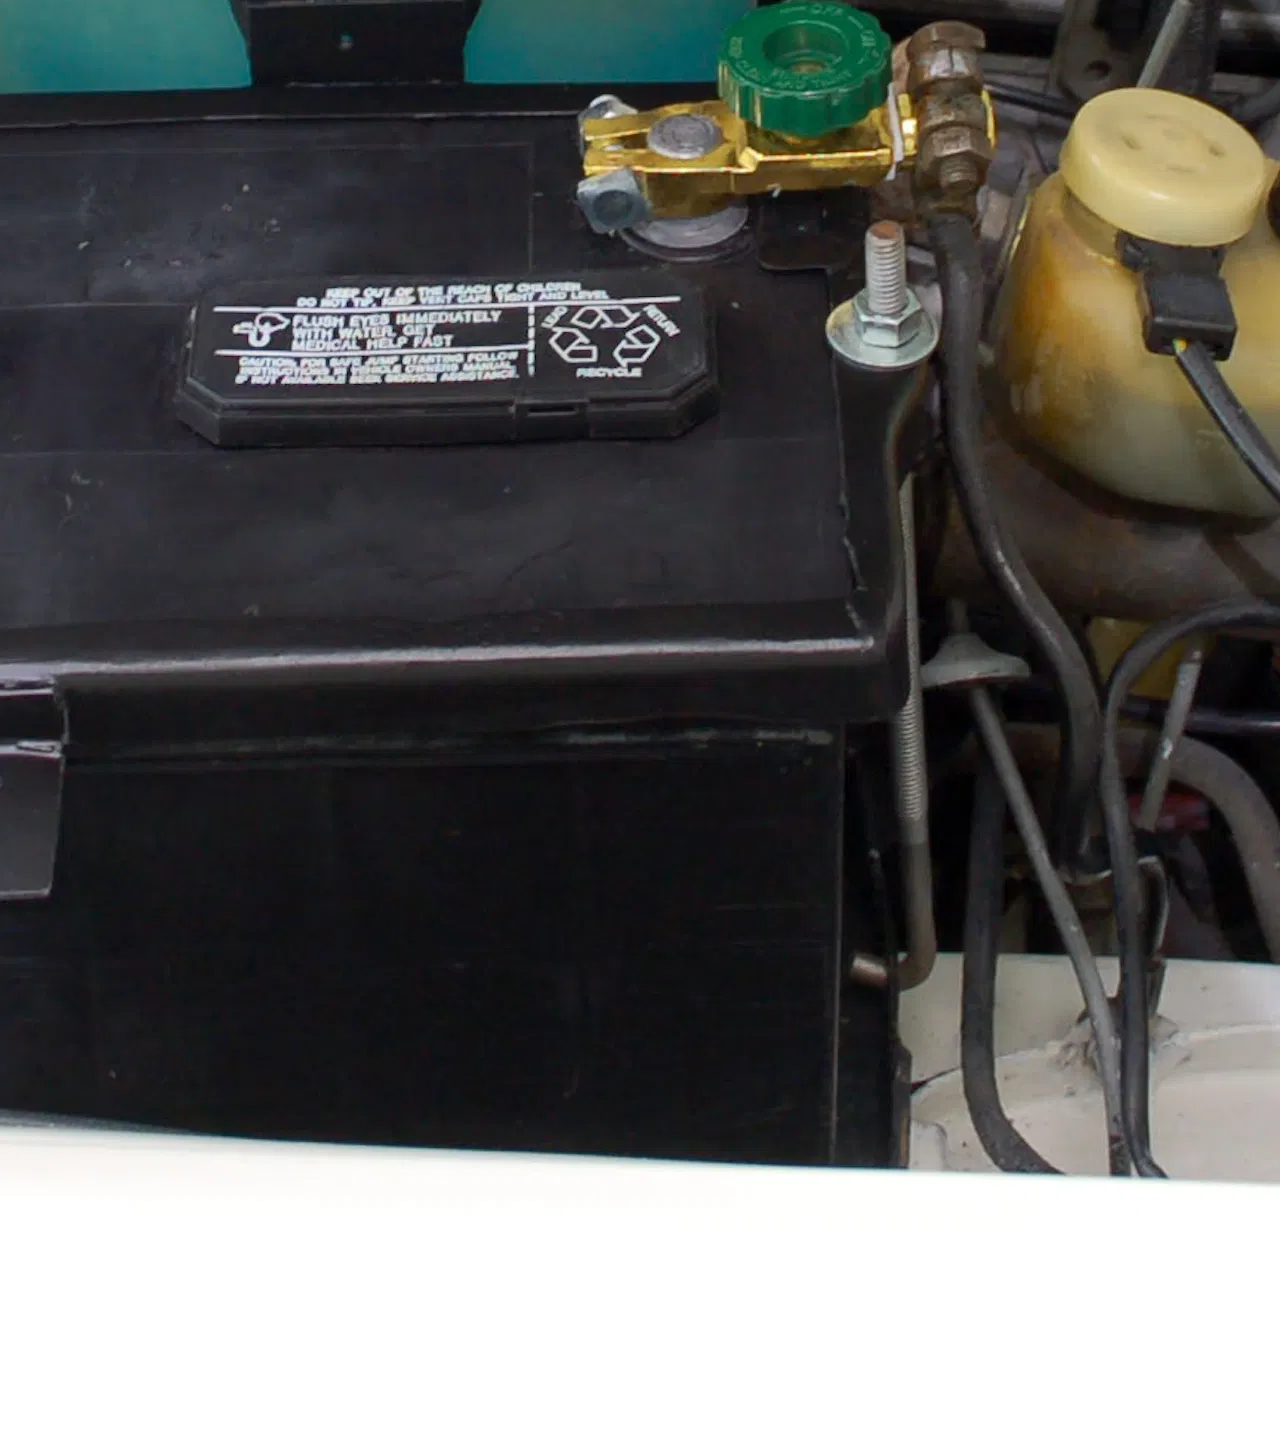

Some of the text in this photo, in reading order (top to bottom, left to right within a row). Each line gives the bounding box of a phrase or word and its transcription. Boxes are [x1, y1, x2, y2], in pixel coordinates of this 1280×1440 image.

[296, 296, 318, 308] DO
[320, 296, 348, 308] NOT
[381, 295, 417, 306] KEEP
[419, 294, 454, 305] VENT
[456, 292, 492, 303] CAPS
[497, 291, 535, 303] TIGHT
[538, 290, 568, 301] AND
[325, 281, 582, 299] KEEP OUT OF THE REACH OF CHILDREN
[292, 309, 502, 329] FLUSH EYES IMMEDIATELY
[540, 305, 569, 329] LEAD
[642, 303, 682, 338] RETURN
[292, 326, 333, 341] WITH
[402, 322, 438, 337] GET
[291, 333, 456, 352] MEDICAL HELP FAST
[299, 355, 326, 368] FOR
[328, 355, 362, 367] SAFE
[365, 355, 400, 366] JUMP
[402, 353, 465, 365] STARTING
[467, 350, 520, 362] FOLLOW
[238, 366, 330, 376] INSTRUCTIONS
[350, 364, 402, 375] VEHICLE
[575, 366, 643, 379] RECYCLE
[250, 374, 277, 385] NOT
[280, 374, 347, 385] AVAILABLE
